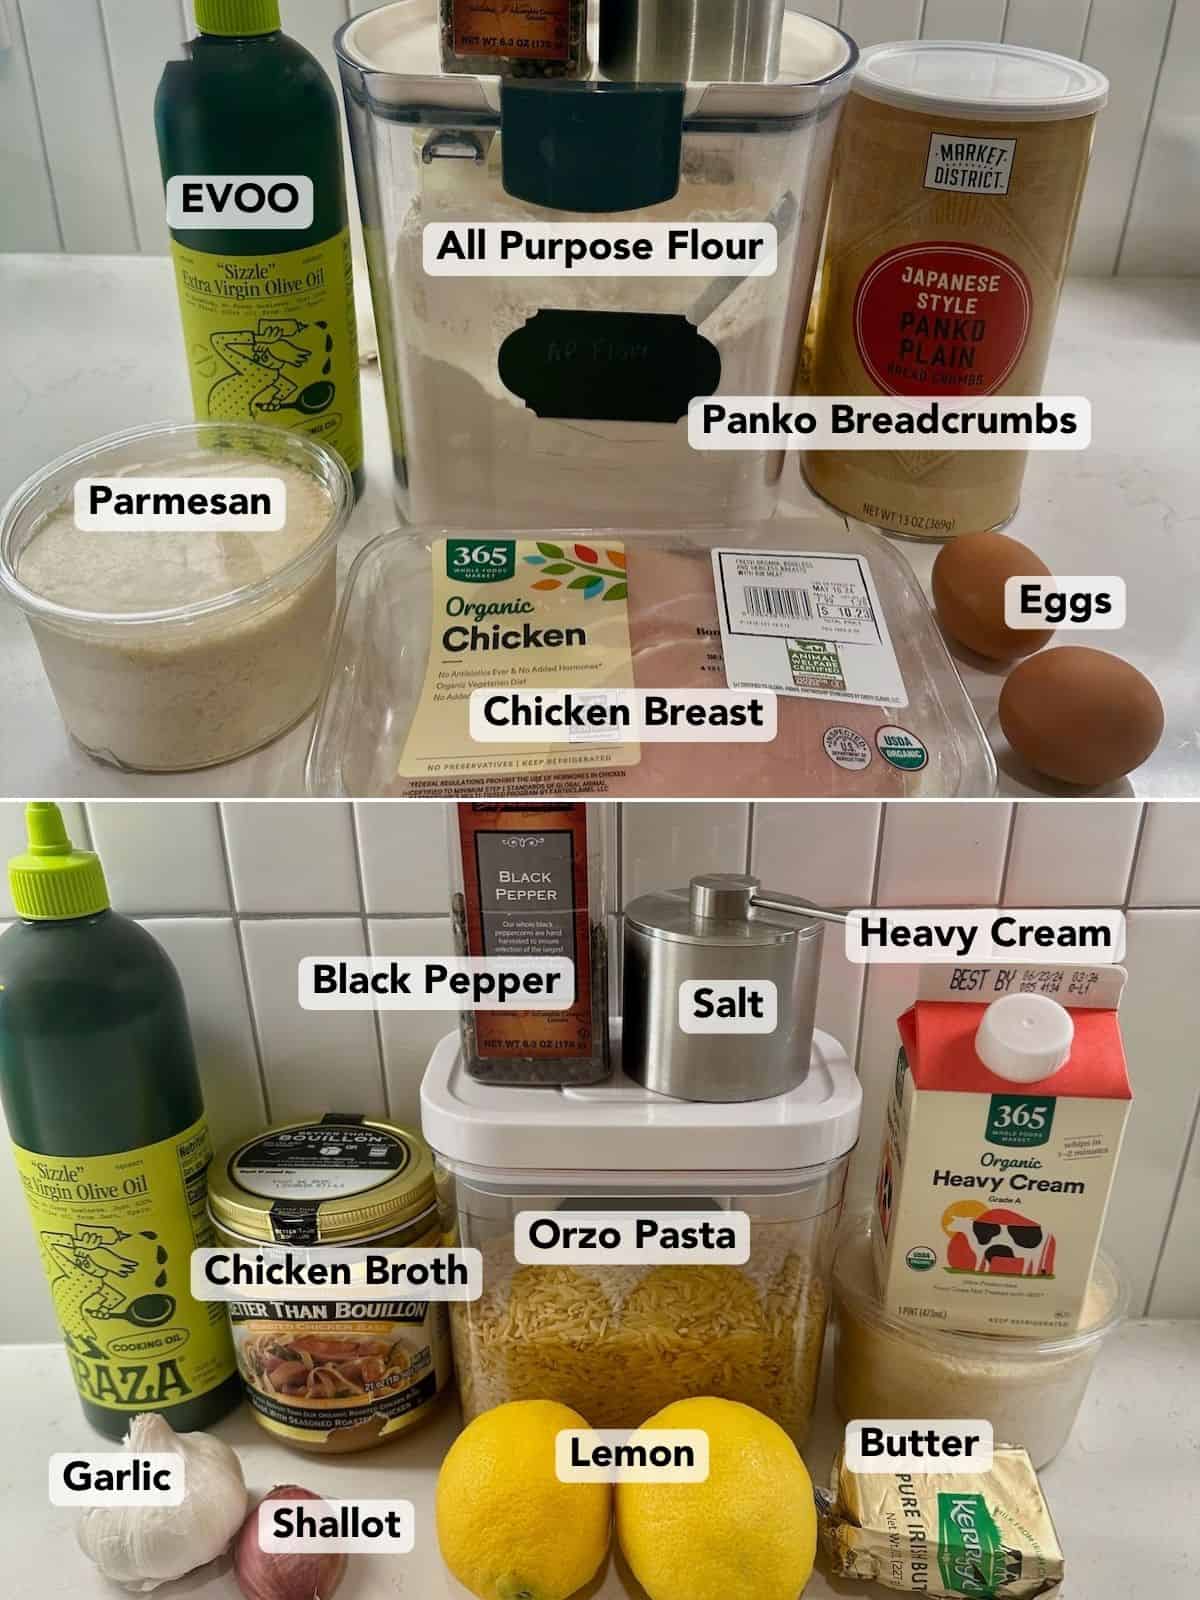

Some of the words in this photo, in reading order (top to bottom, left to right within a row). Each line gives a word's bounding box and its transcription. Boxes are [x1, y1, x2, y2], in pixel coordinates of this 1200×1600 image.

[940, 143, 1009, 167] MARKET
[934, 166, 1004, 190] DISTRICT
[183, 270, 211, 293] Extra
[215, 280, 259, 300] Virgin
[265, 278, 302, 295] Olive
[306, 268, 324, 288] Oil
[902, 266, 1001, 293] JAPANESE
[917, 292, 978, 315] STYLE
[900, 313, 985, 343] PANKO
[899, 337, 975, 370] PLAIN
[453, 544, 507, 566] 365
[446, 596, 535, 622] Organic
[442, 623, 587, 653] Chicken
[884, 735, 913, 747] USDA
[427, 764, 441, 772] NO
[443, 761, 514, 770] PRESERVATIVES
[499, 870, 552, 883] BLACK
[496, 888, 557, 901] PEPPER
[950, 968, 991, 991] BEST
[994, 968, 1017, 992] BY
[993, 1103, 1048, 1130] 365
[279, 1135, 383, 1143] BOUILLON
[980, 1152, 1042, 1172] Organic
[77, 1183, 118, 1201] Olive
[123, 1175, 148, 1196] Oil
[932, 1169, 1003, 1193] Heavy
[1009, 1173, 1085, 1195] Cream
[270, 1301, 327, 1320] THAN
[335, 1301, 426, 1319] BOUILLON
[112, 1337, 163, 1353] COOKING
[164, 1333, 183, 1346] OIL
[896, 1473, 921, 1518] PURE
